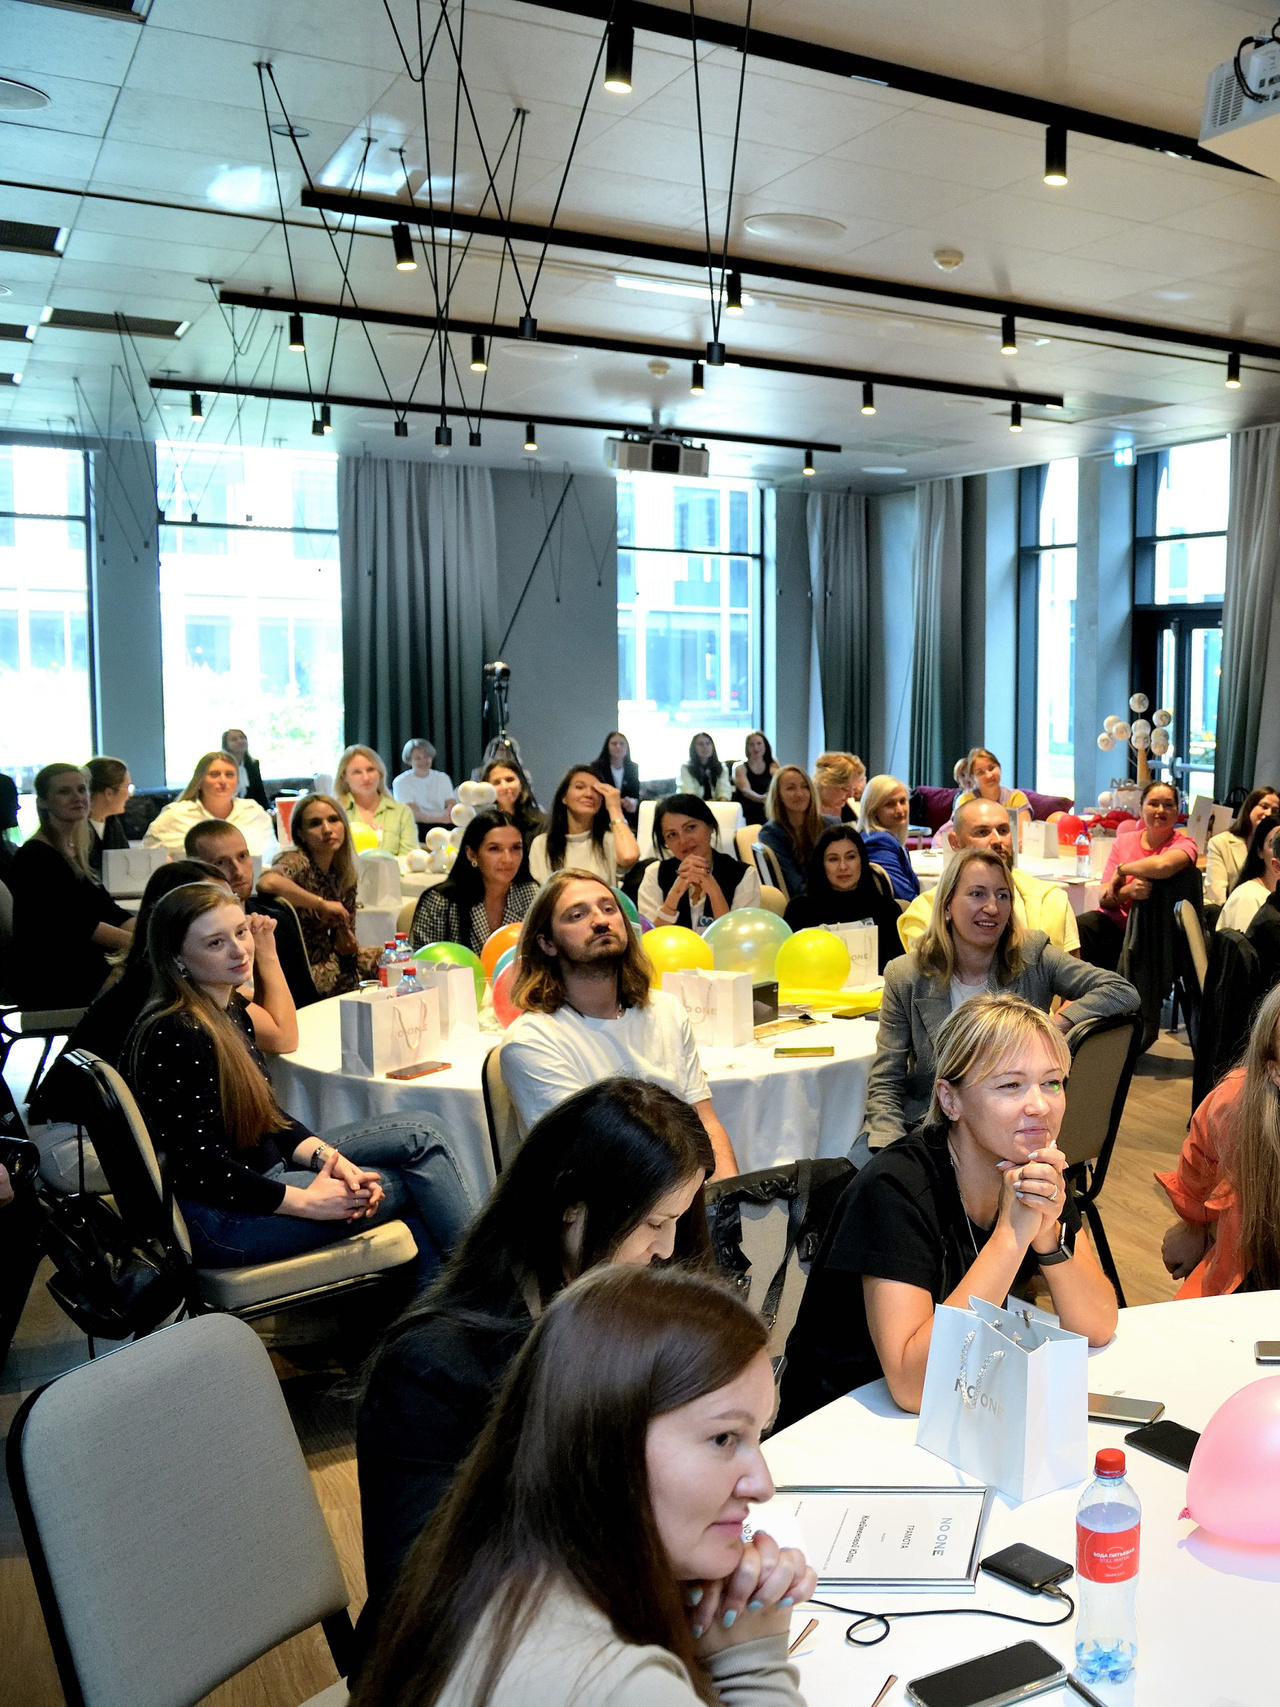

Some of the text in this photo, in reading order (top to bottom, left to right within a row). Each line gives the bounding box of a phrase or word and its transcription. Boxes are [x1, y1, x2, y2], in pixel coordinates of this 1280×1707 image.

[1110, 778, 1135, 790] NO
[900, 1524, 915, 1550] ГРАМОТА
[932, 1517, 953, 1557] NO ONE
[1093, 1547, 1135, 1559] ВОДА ПИТЬЕВАЯ
